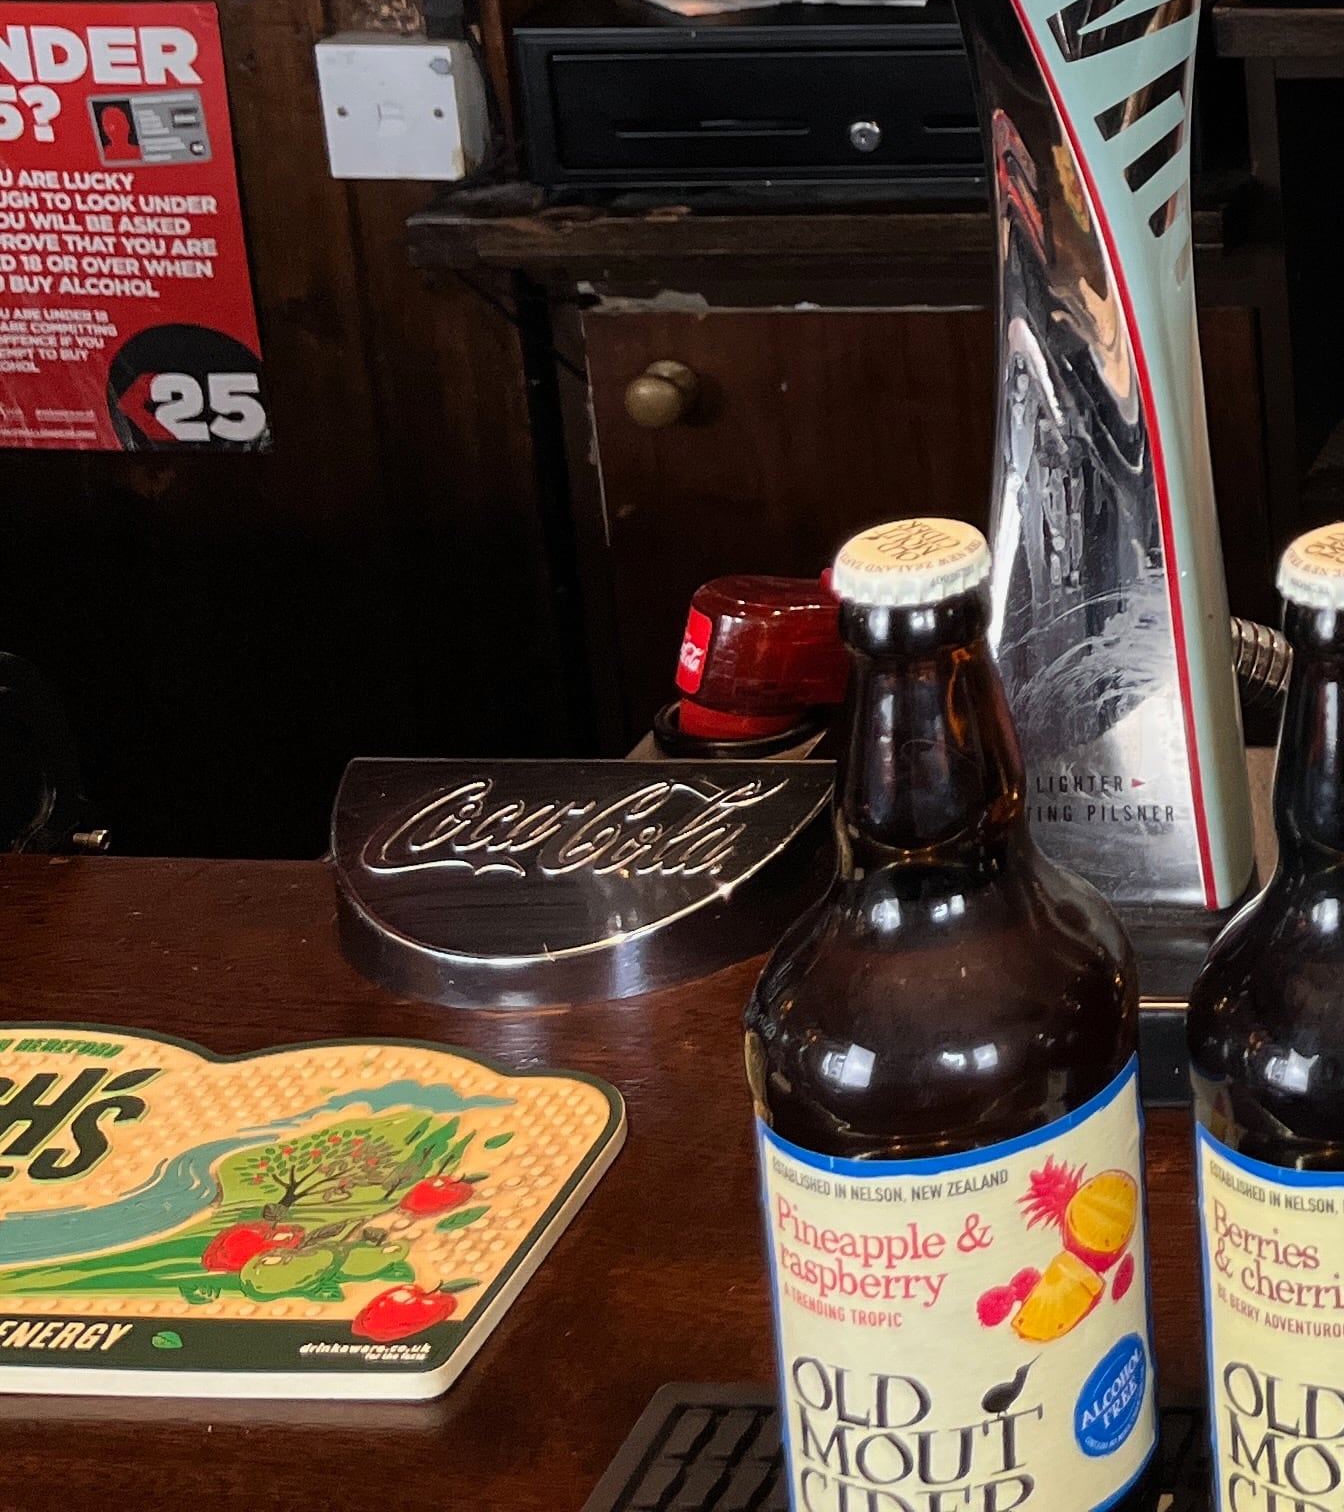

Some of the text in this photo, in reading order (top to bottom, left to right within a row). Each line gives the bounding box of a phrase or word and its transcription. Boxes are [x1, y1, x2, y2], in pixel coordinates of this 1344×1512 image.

[18, 169, 135, 192] ARE LUCKY
[40, 192, 218, 215] TO LOOK UNDER
[29, 211, 192, 236] WILL BE ASKED
[62, 233, 219, 258] THAT YOU ARE
[46, 254, 215, 279] OR OVER WHEN
[8, 274, 161, 299] BUY ALCOHOL
[147, 371, 267, 443] 25
[1035, 775, 1124, 794] LIGHTER
[1087, 803, 1175, 823] PILSNER
[772, 1156, 1009, 1202] ESTABLISHED IN NELSON, NEW ZEALAND
[1209, 1159, 1267, 1204] ESTABLISHED
[1269, 1193, 1282, 1207] IN
[1284, 1195, 1340, 1215] NELSON,
[776, 1192, 994, 1269] Pineapple &
[1212, 1199, 1321, 1271] Berries
[780, 1243, 948, 1308] raspberry
[1213, 1247, 1234, 1280] &
[849, 1307, 903, 1328] TROPIC
[1229, 1290, 1261, 1324] BERRY
[791, 1355, 932, 1430] OLD
[1079, 1344, 1144, 1433] ALCOHOL
[1100, 1378, 1139, 1429] FREE
[794, 1399, 1044, 1486] MOUT
